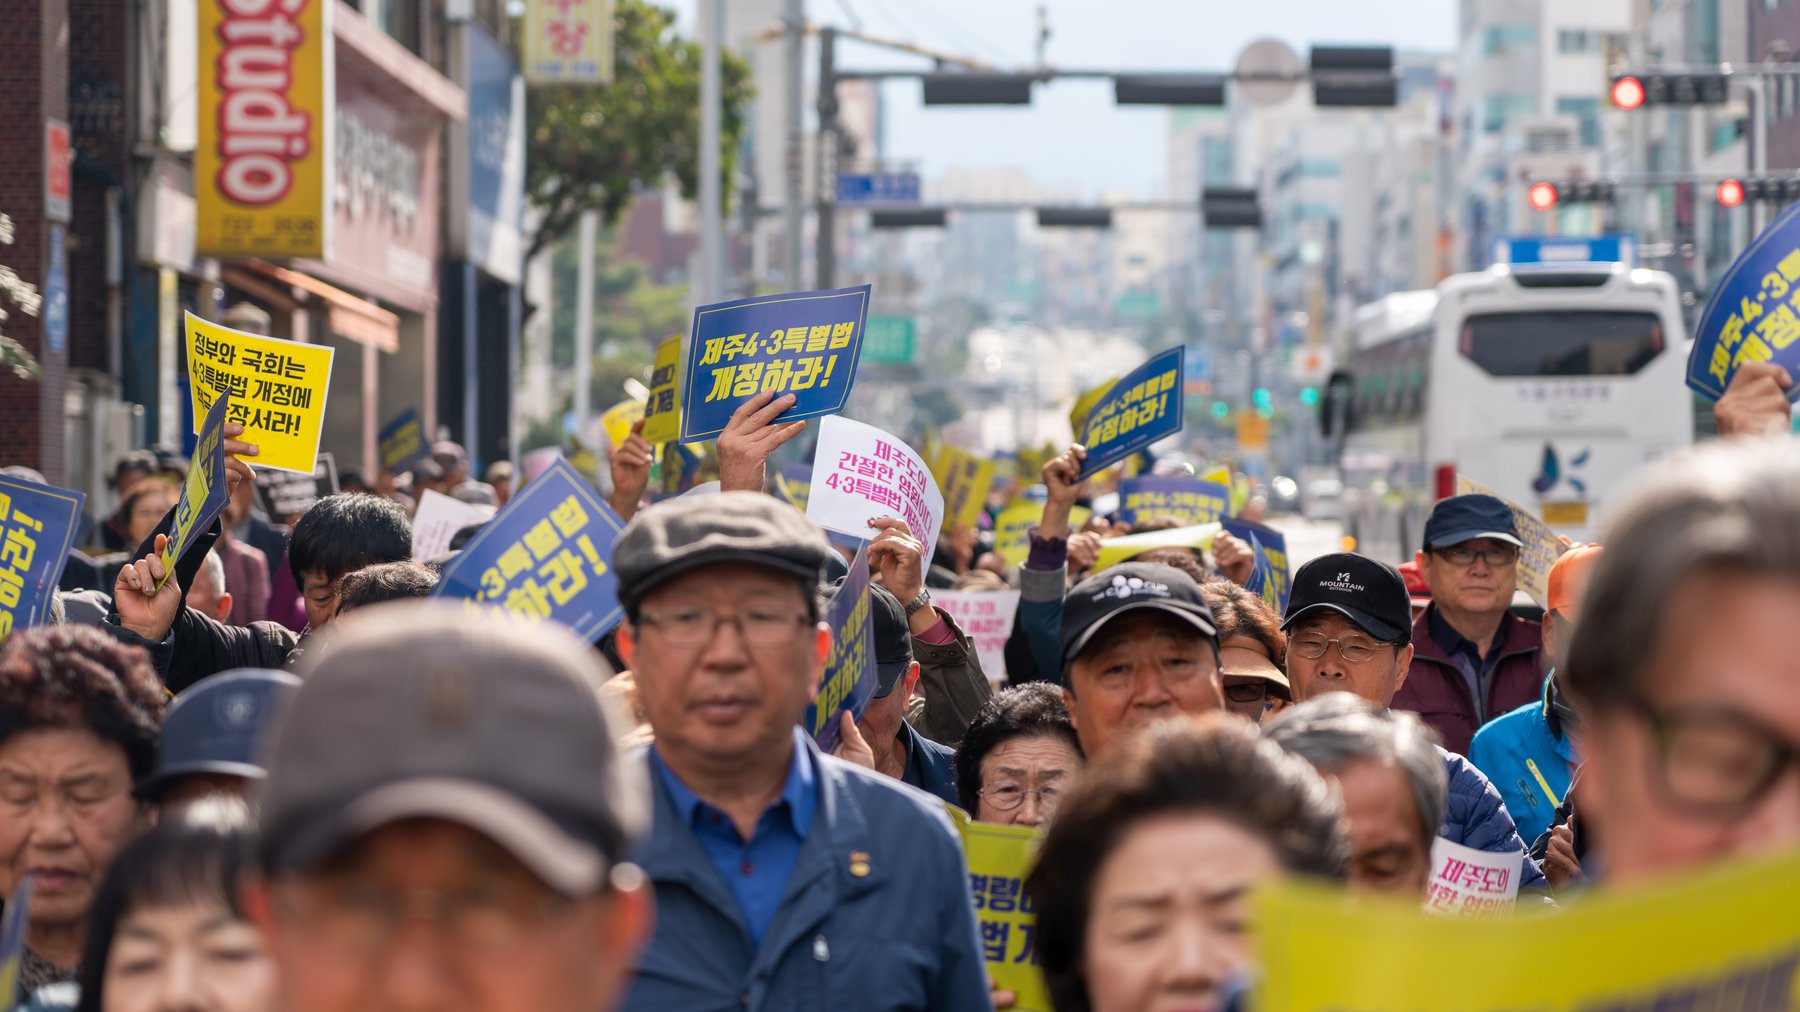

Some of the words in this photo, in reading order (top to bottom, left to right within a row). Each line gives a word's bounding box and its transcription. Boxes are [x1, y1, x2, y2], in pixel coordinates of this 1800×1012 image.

[194, 331, 236, 366] 정부와
[242, 348, 306, 380] 국회는
[699, 321, 855, 366] 제주4·3특별법
[192, 358, 249, 399] 4·3특별법
[252, 379, 312, 409] 개정에
[705, 354, 838, 403] 개정하라!
[224, 403, 301, 437] 장서라!
[873, 439, 927, 494] 제주도의
[825, 472, 902, 512] 4·3특별법
[838, 451, 894, 485] 간절한
[898, 475, 933, 535] 염원이다
[490, 533, 608, 620] 하라!
[1320, 580, 1365, 592] MOUNTAIN
[1438, 857, 1510, 893] 제주도의
